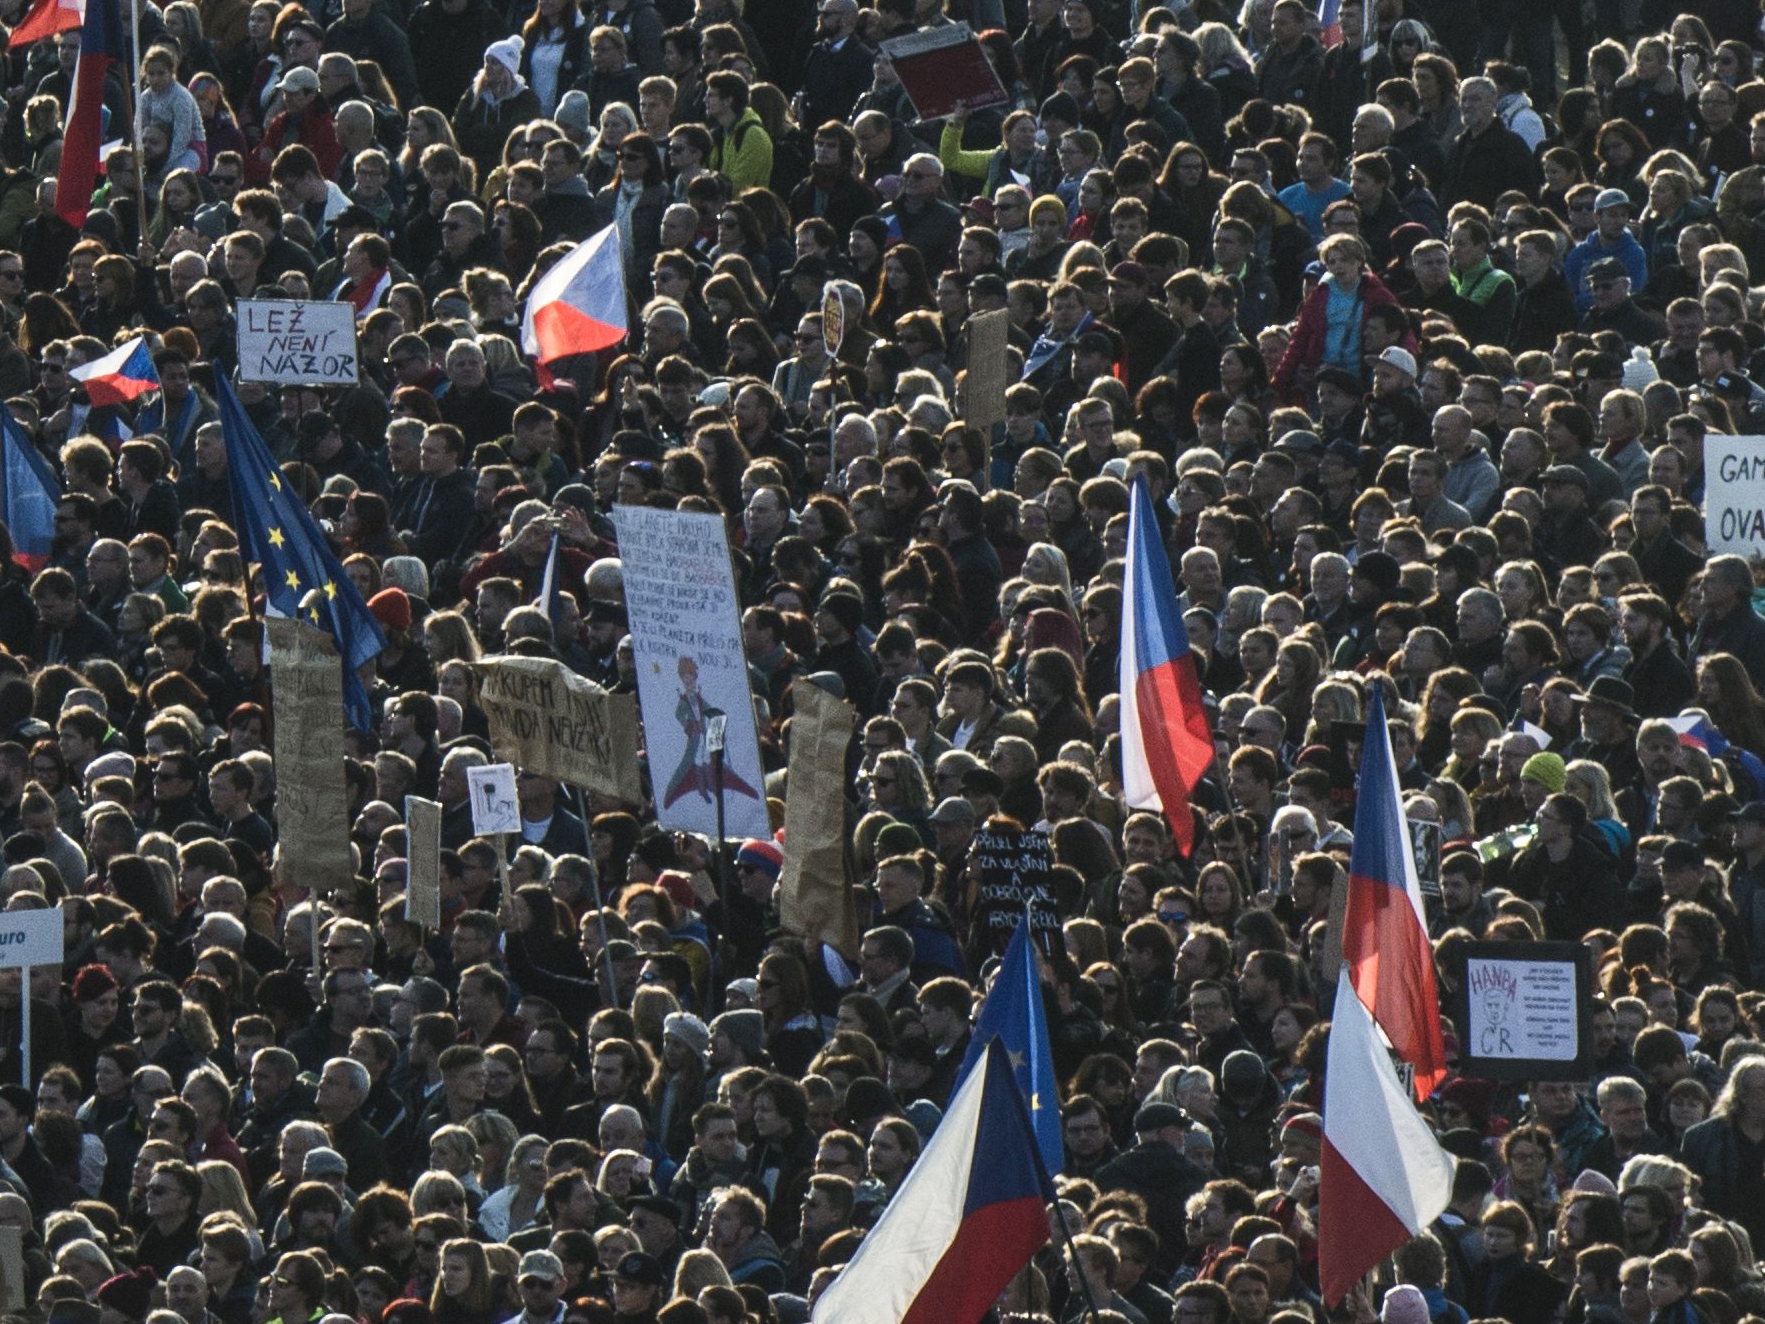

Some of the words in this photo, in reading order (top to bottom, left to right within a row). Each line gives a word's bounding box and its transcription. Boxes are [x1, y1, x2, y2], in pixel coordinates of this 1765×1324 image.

[247, 301, 308, 334] LEŽ
[268, 329, 339, 353] NENÍ
[259, 349, 355, 379] NÁZOR
[1469, 965, 1518, 1002] HANBA
